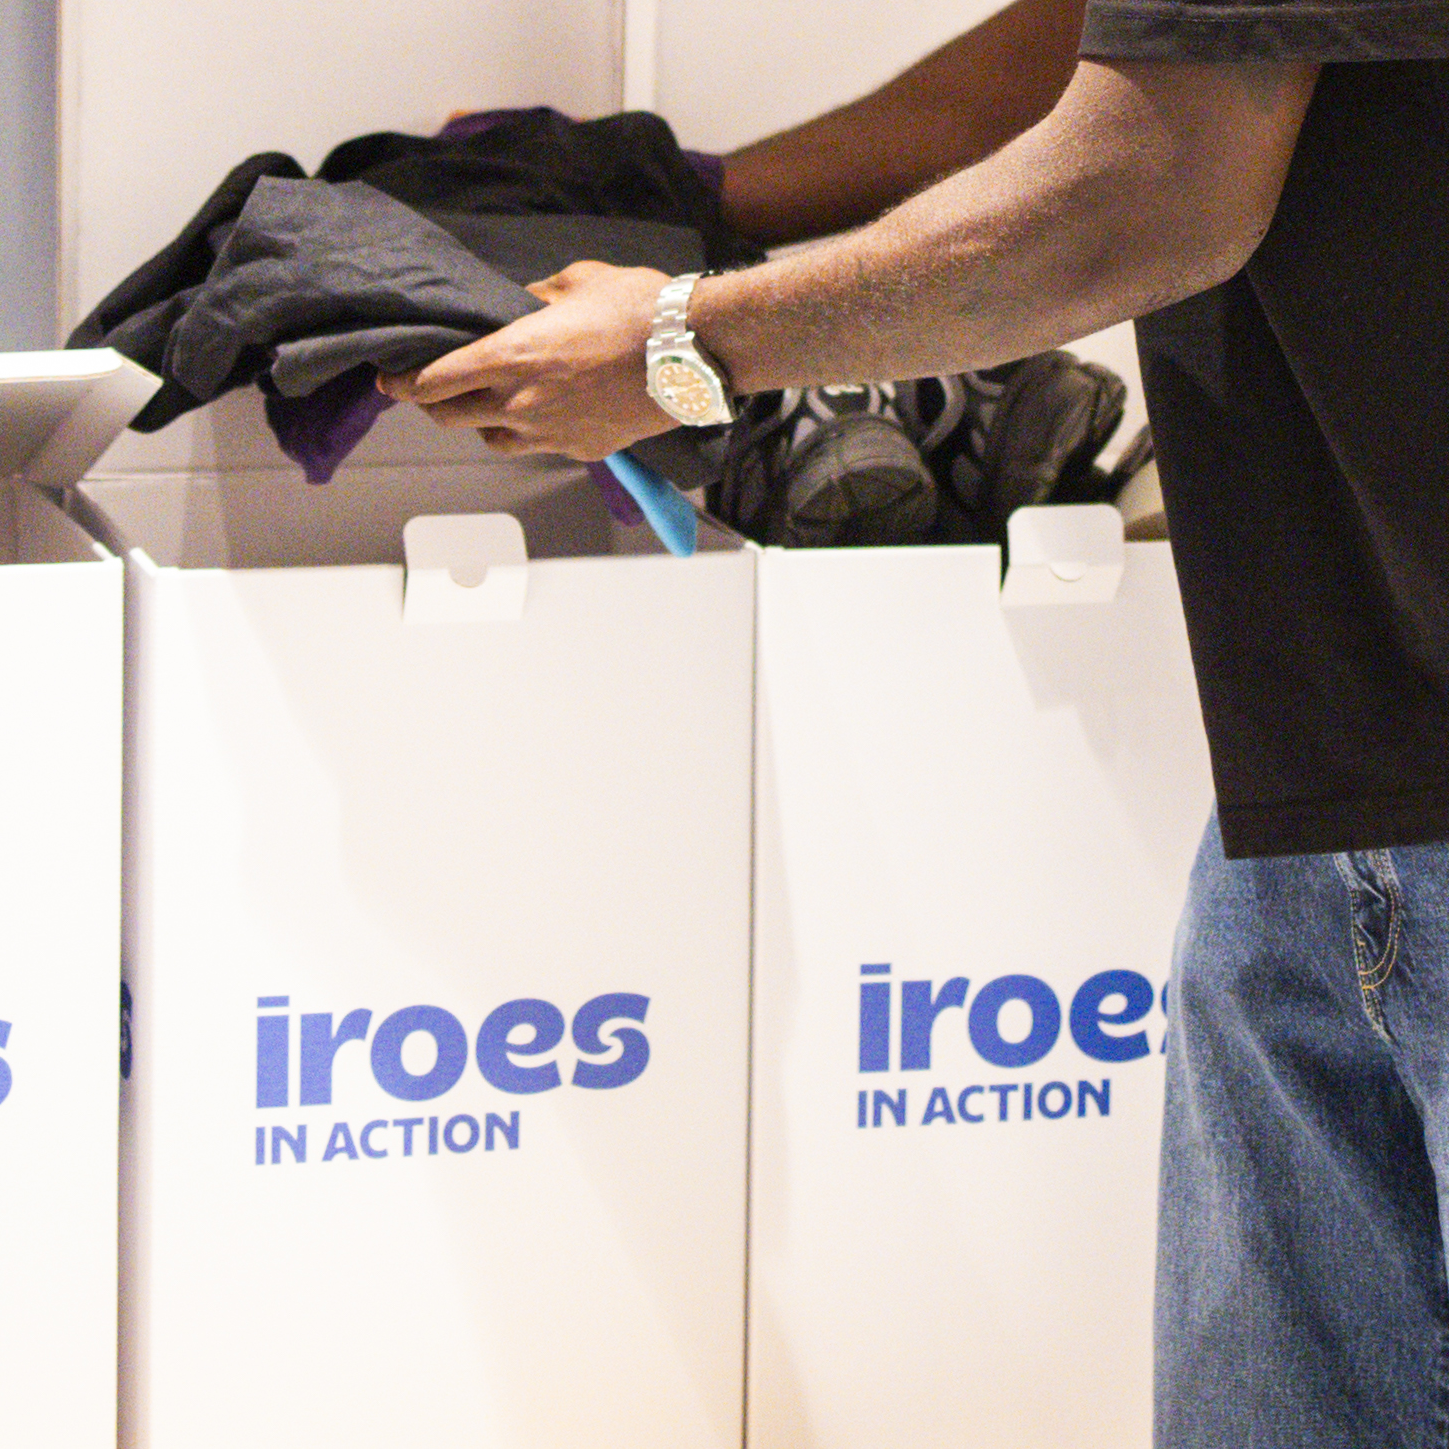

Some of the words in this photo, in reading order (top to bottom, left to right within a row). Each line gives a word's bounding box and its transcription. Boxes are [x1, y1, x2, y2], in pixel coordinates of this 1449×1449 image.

[255, 992, 651, 1109] iroes
[858, 963, 1169, 1074] iroe
[255, 1124, 308, 1166] IN
[322, 1110, 521, 1162] ACTION
[857, 1088, 908, 1129] IN
[921, 1078, 1112, 1126] ACTION
